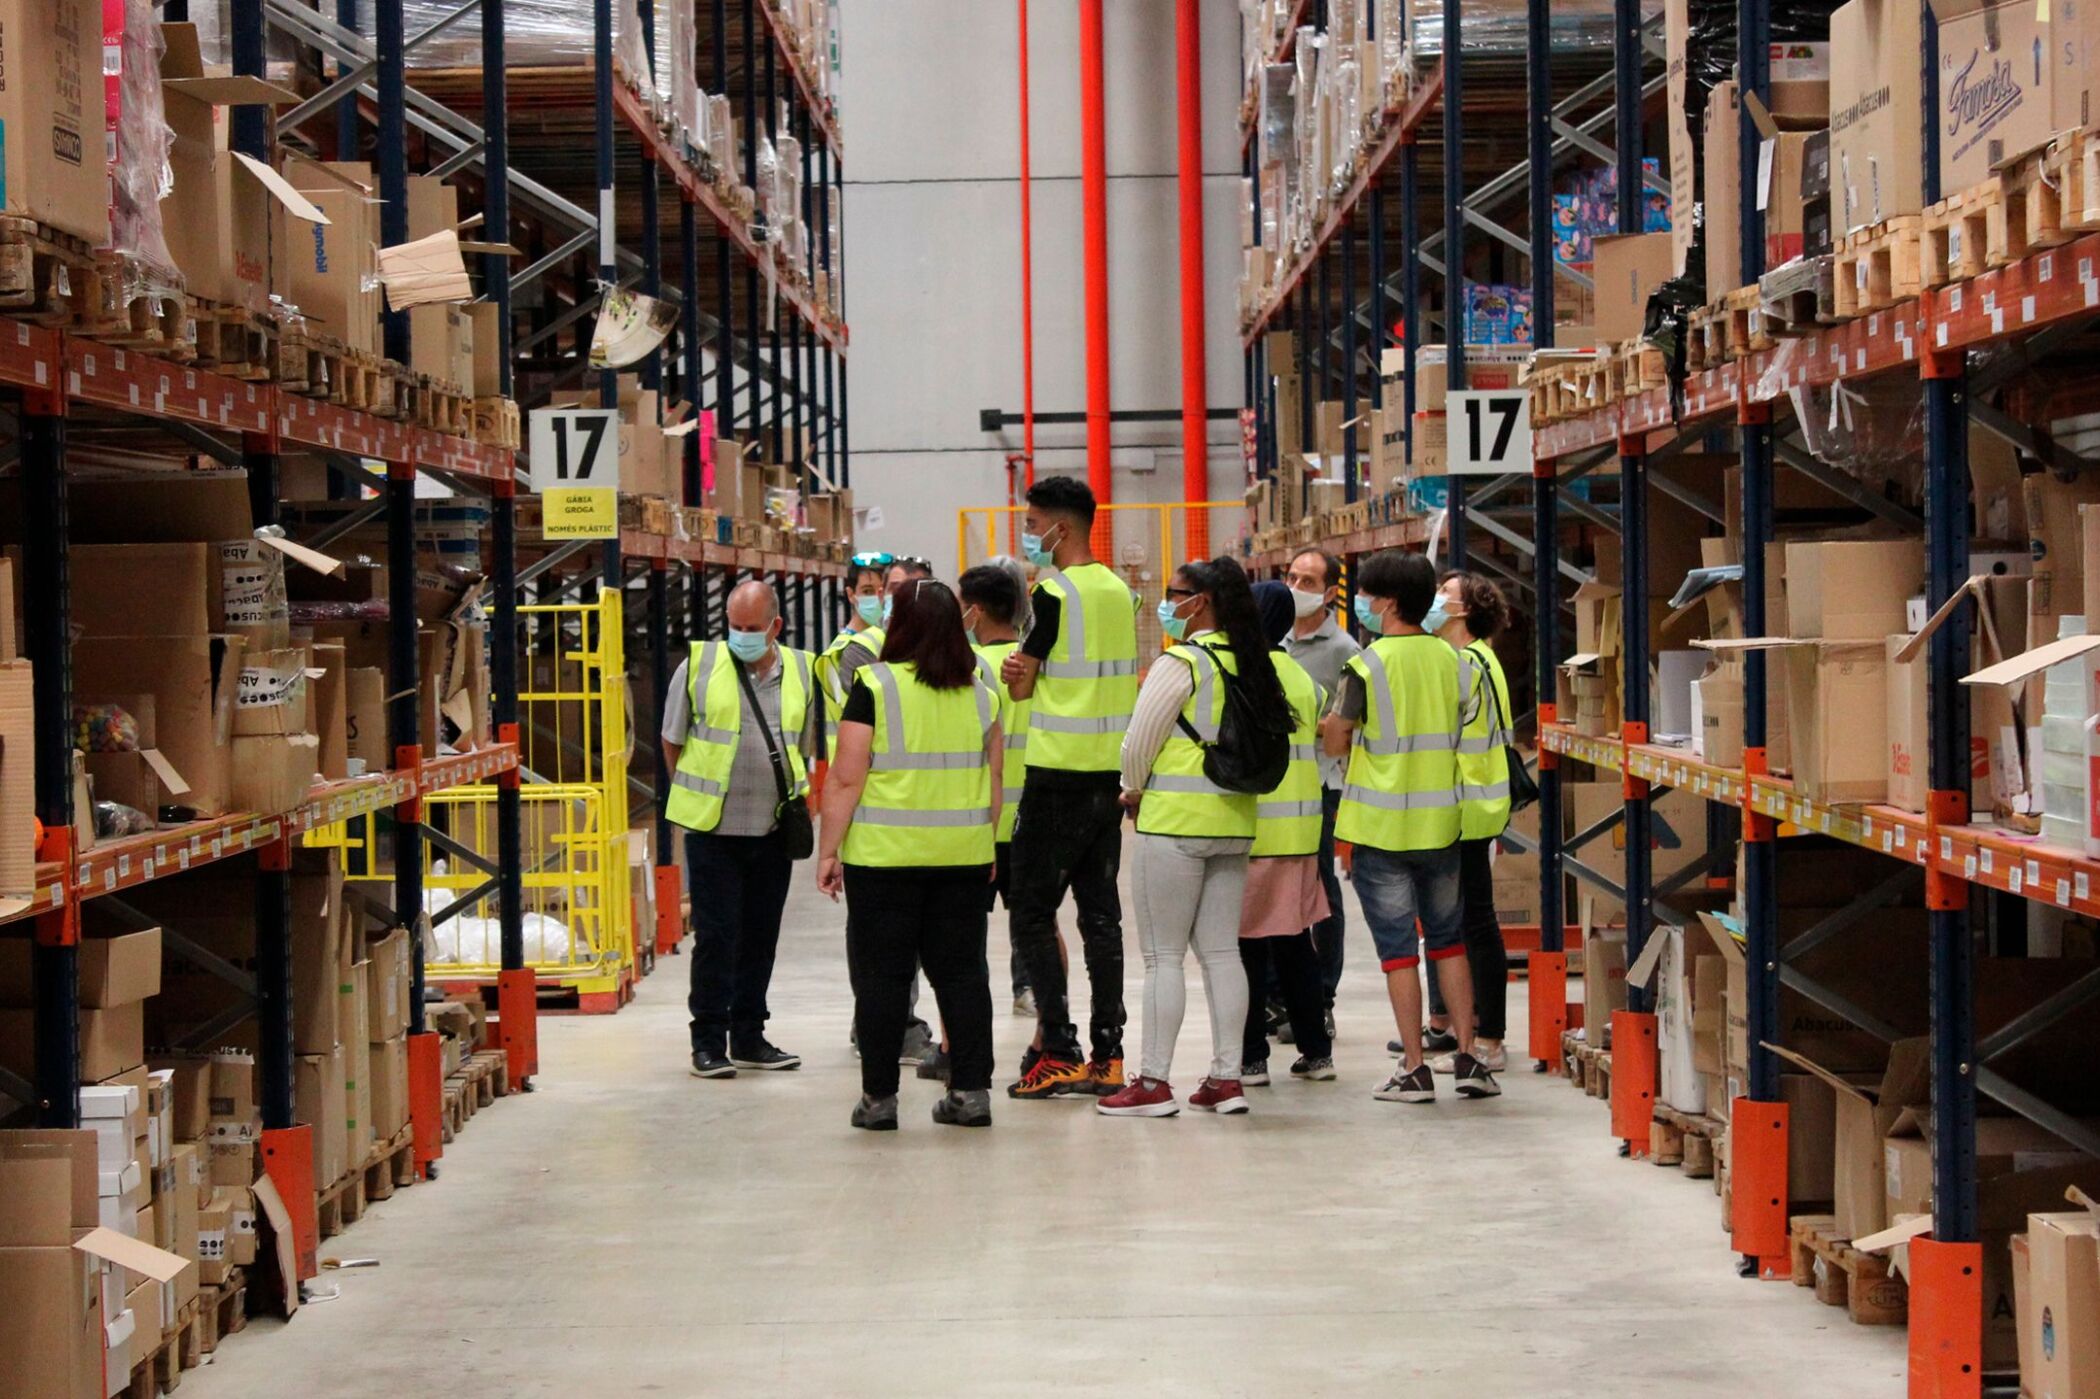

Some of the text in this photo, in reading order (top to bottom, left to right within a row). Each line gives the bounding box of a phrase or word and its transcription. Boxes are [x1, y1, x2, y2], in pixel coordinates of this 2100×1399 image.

[1949, 48, 2013, 136] Famosa
[551, 416, 609, 479] 17
[1465, 398, 1523, 462] 17
[547, 523, 577, 533] NOMÉS
[564, 506, 595, 514] GROGA
